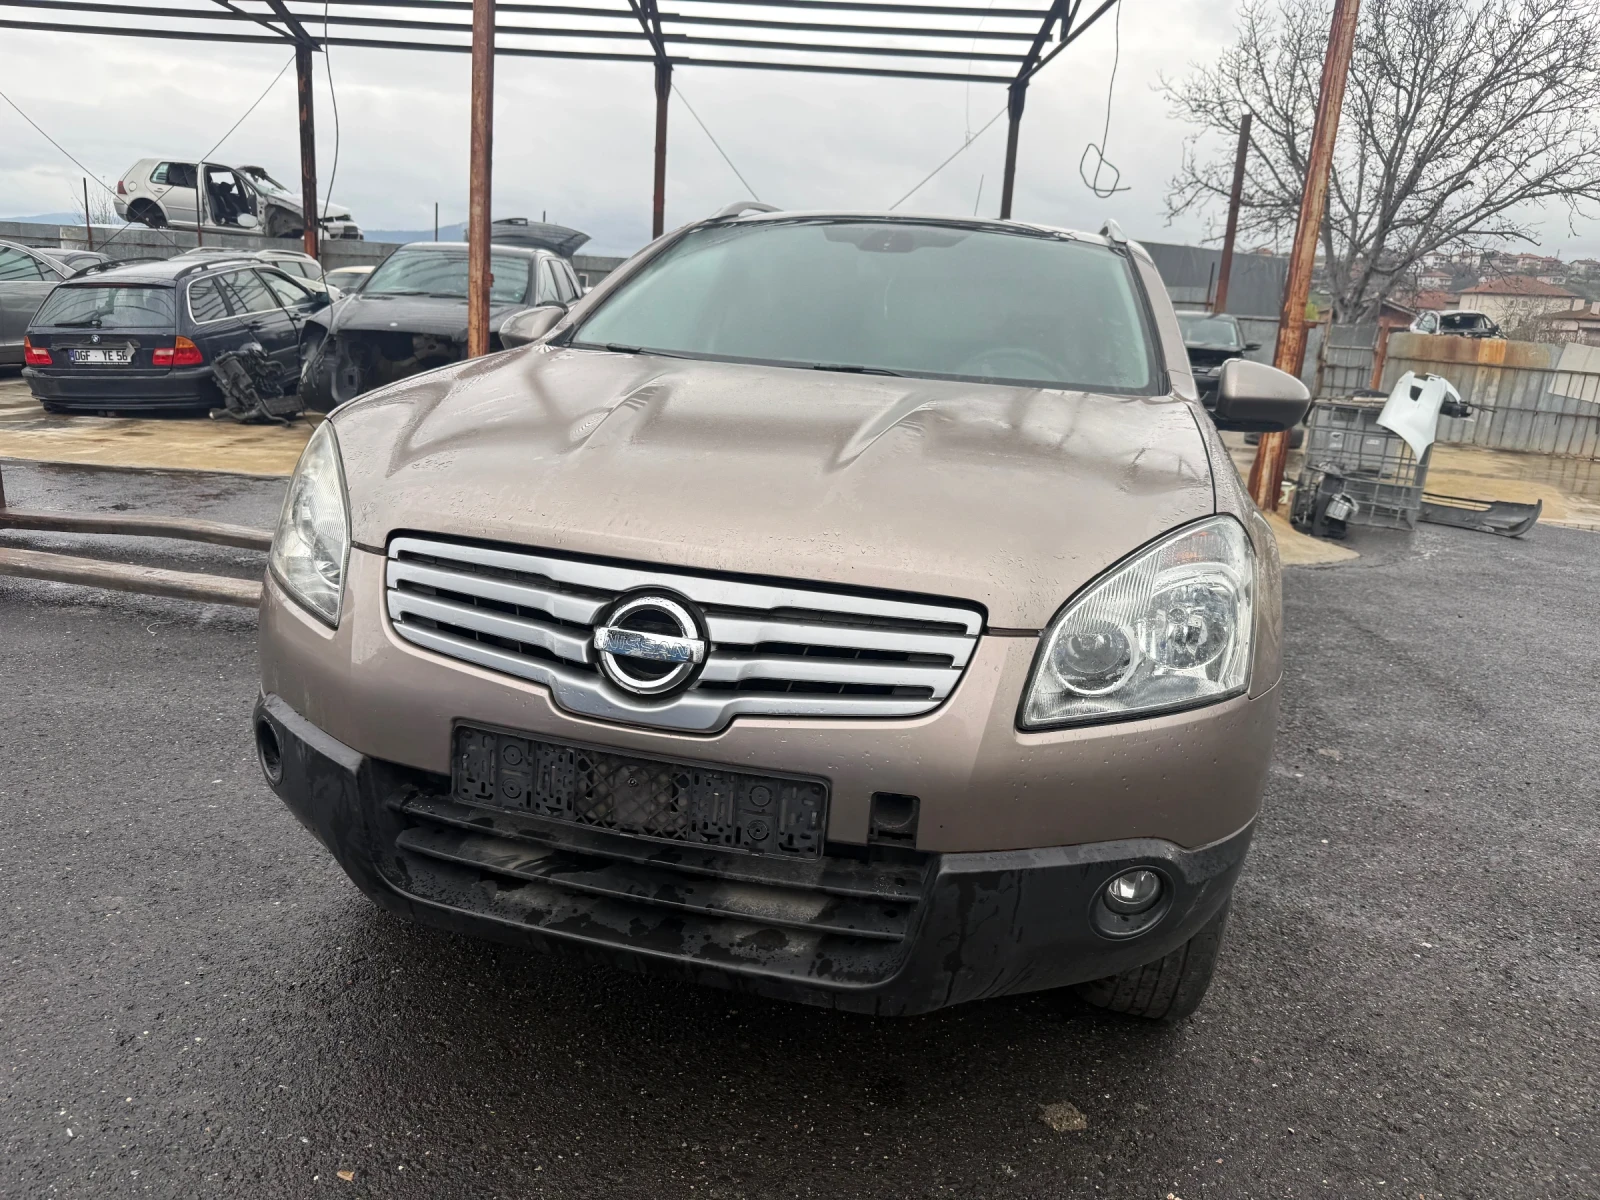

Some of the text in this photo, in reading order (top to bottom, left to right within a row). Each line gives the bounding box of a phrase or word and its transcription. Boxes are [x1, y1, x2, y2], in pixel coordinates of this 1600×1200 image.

[75, 350, 90, 361] DGF
[102, 350, 114, 361] YE
[603, 633, 690, 659] NISSAN
